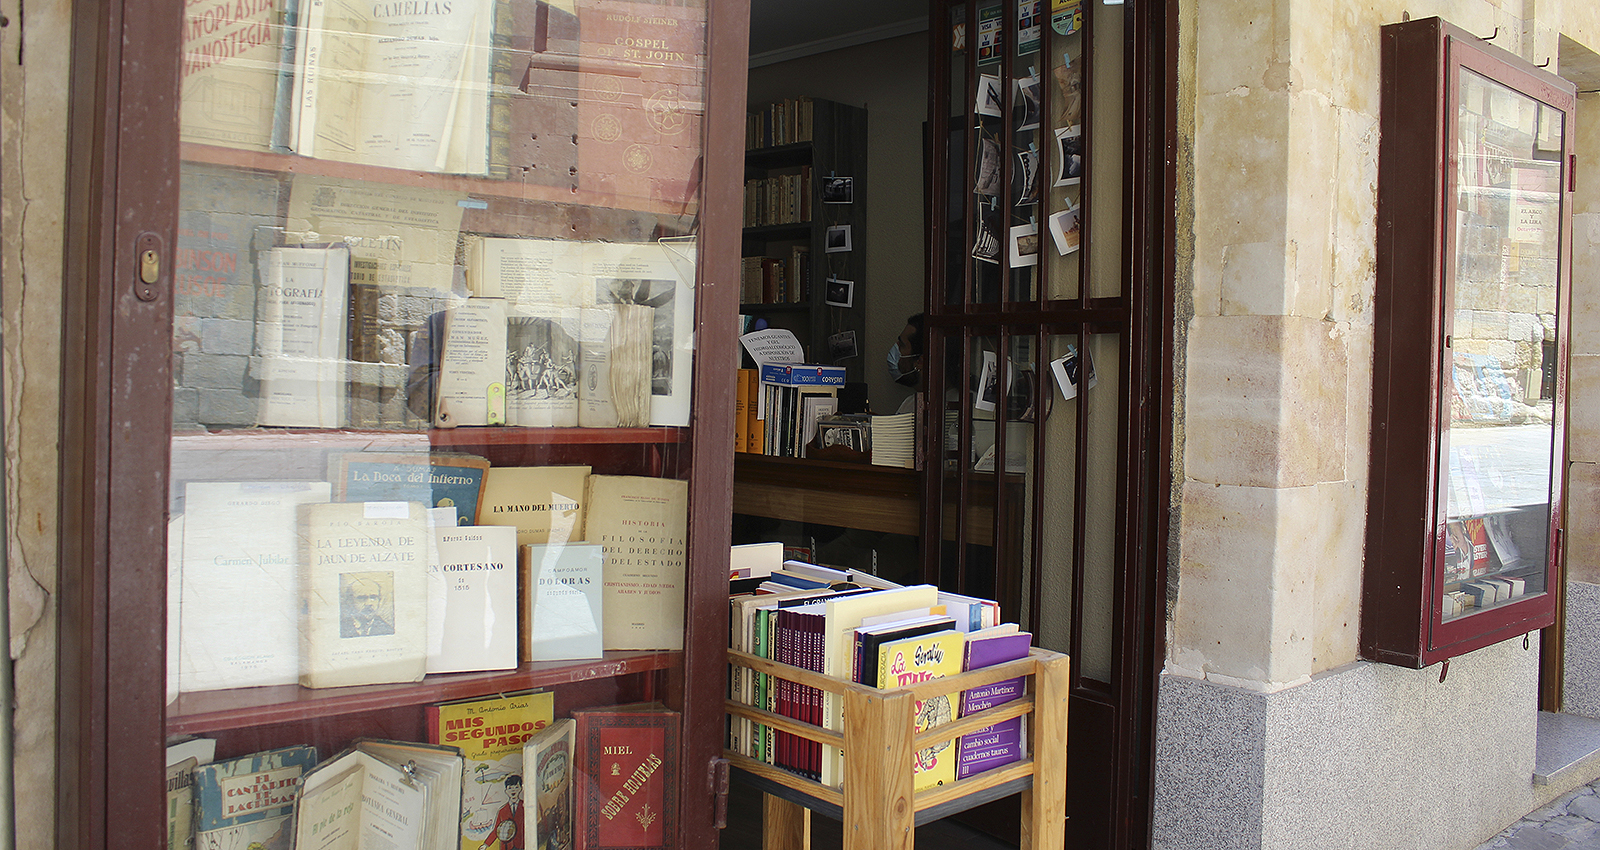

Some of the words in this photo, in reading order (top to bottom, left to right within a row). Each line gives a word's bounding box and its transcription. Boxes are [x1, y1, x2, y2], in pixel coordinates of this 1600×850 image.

[372, 2, 452, 18] CAMELIAS
[184, 0, 273, 43] ANOPLASTIA
[606, 13, 642, 23] RUDOLF
[643, 15, 679, 26] STEINER
[183, 18, 272, 78] VANOSTEGIA
[614, 37, 669, 50] GOSPEL
[597, 48, 615, 57] OF
[623, 48, 641, 59] ST.
[645, 51, 685, 61] JOHN
[307, 46, 317, 84] RUINAS
[305, 90, 314, 108] LAS
[176, 247, 237, 273] BINSON
[174, 274, 227, 297] USOE
[353, 470, 370, 482] La
[373, 471, 402, 483] Boca
[407, 473, 424, 482] del
[427, 473, 474, 485] Infierno
[493, 504, 504, 513] LA
[506, 503, 530, 513] MANO
[532, 503, 547, 512] DEL
[549, 502, 580, 512] MUERTO
[622, 520, 666, 528] HISTORIA
[317, 539, 332, 549] LA
[338, 537, 392, 548] LEYENDA
[398, 536, 415, 546] DE
[602, 535, 683, 545] FILOSOFIA
[602, 546, 623, 554] DEL
[628, 547, 683, 557] DERECHO
[213, 554, 252, 567] Carmen
[258, 553, 289, 566] Jubilar
[317, 554, 347, 566] JAUN
[350, 553, 366, 563] DE
[369, 552, 416, 563] ALZATE
[611, 558, 632, 566] DEL
[637, 559, 682, 567] ESTADO
[443, 562, 504, 573] CORTESANO
[539, 576, 591, 586] DOLORAS
[890, 651, 907, 675] La
[968, 688, 990, 700] Antonio
[478, 705, 507, 714] Antonio
[445, 716, 484, 731] MIS
[445, 720, 546, 742] SEGUNDOS
[483, 733, 534, 749] PASO
[963, 739, 984, 750] cambio
[983, 734, 1000, 746] social
[603, 745, 633, 755] MIEL
[962, 751, 991, 762] cuadernos
[991, 747, 1009, 757] taurus
[168, 769, 194, 792] villas
[255, 774, 270, 784] EL
[600, 790, 630, 821] SOBRE
[622, 753, 662, 795] HOJUELAS
[255, 791, 270, 800] DE
